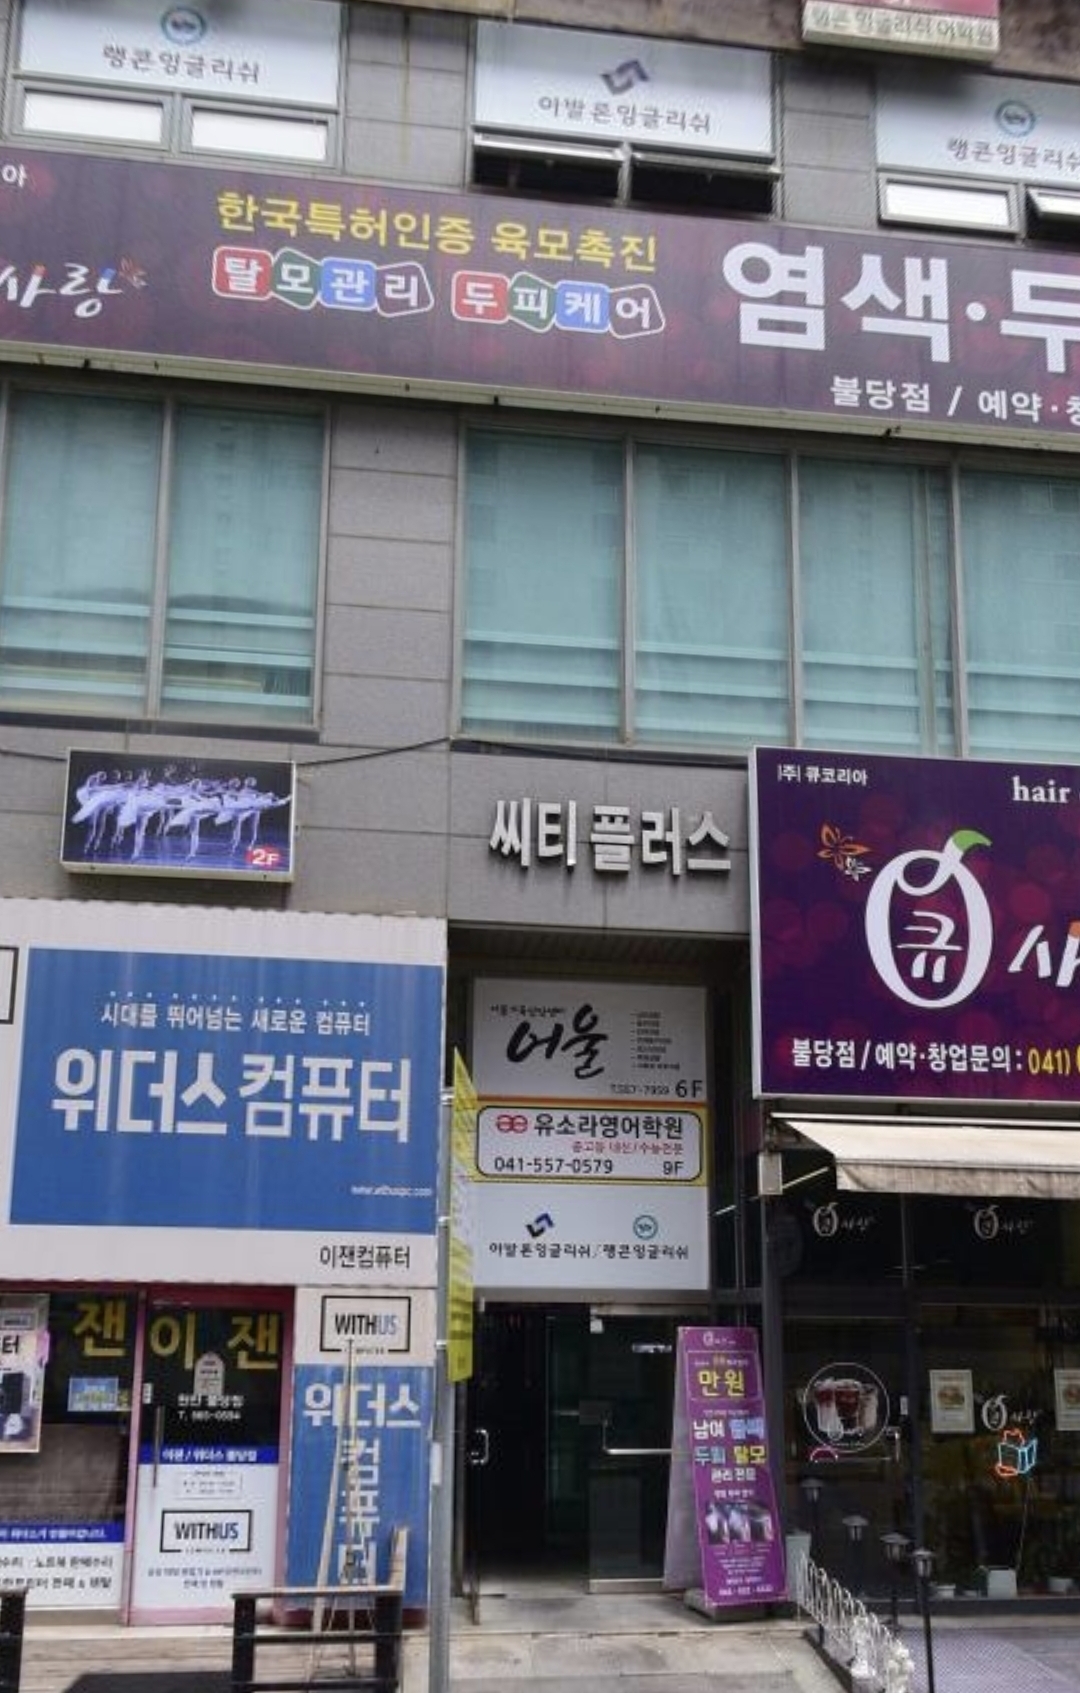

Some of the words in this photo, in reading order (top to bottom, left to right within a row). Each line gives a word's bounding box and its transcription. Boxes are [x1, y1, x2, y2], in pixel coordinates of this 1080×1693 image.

[217, 191, 476, 256] 한국특허인증
[490, 222, 657, 273] 육모촉진
[223, 255, 420, 308] 탈모관리
[461, 281, 652, 330] 두피케어
[830, 375, 931, 414] 불당점
[804, 765, 868, 788] 큐코리아
[1012, 774, 1072, 803] hair
[252, 848, 279, 866] 2F
[100, 1003, 158, 1028] 시대를
[166, 1005, 242, 1033] 뛰어넘는
[252, 1007, 307, 1035] 새로운
[315, 1010, 371, 1037] 컴퓨터
[506, 1003, 609, 1080] 어울
[791, 1037, 856, 1070] 불당점
[674, 1079, 703, 1099] 6F
[534, 1113, 685, 1141] 유소라영어학원
[493, 1156, 614, 1175] 041-557-0579
[662, 1160, 685, 1176] 9F
[334, 1313, 398, 1336] WITHUS
[174, 1521, 240, 1540] WITHUS
